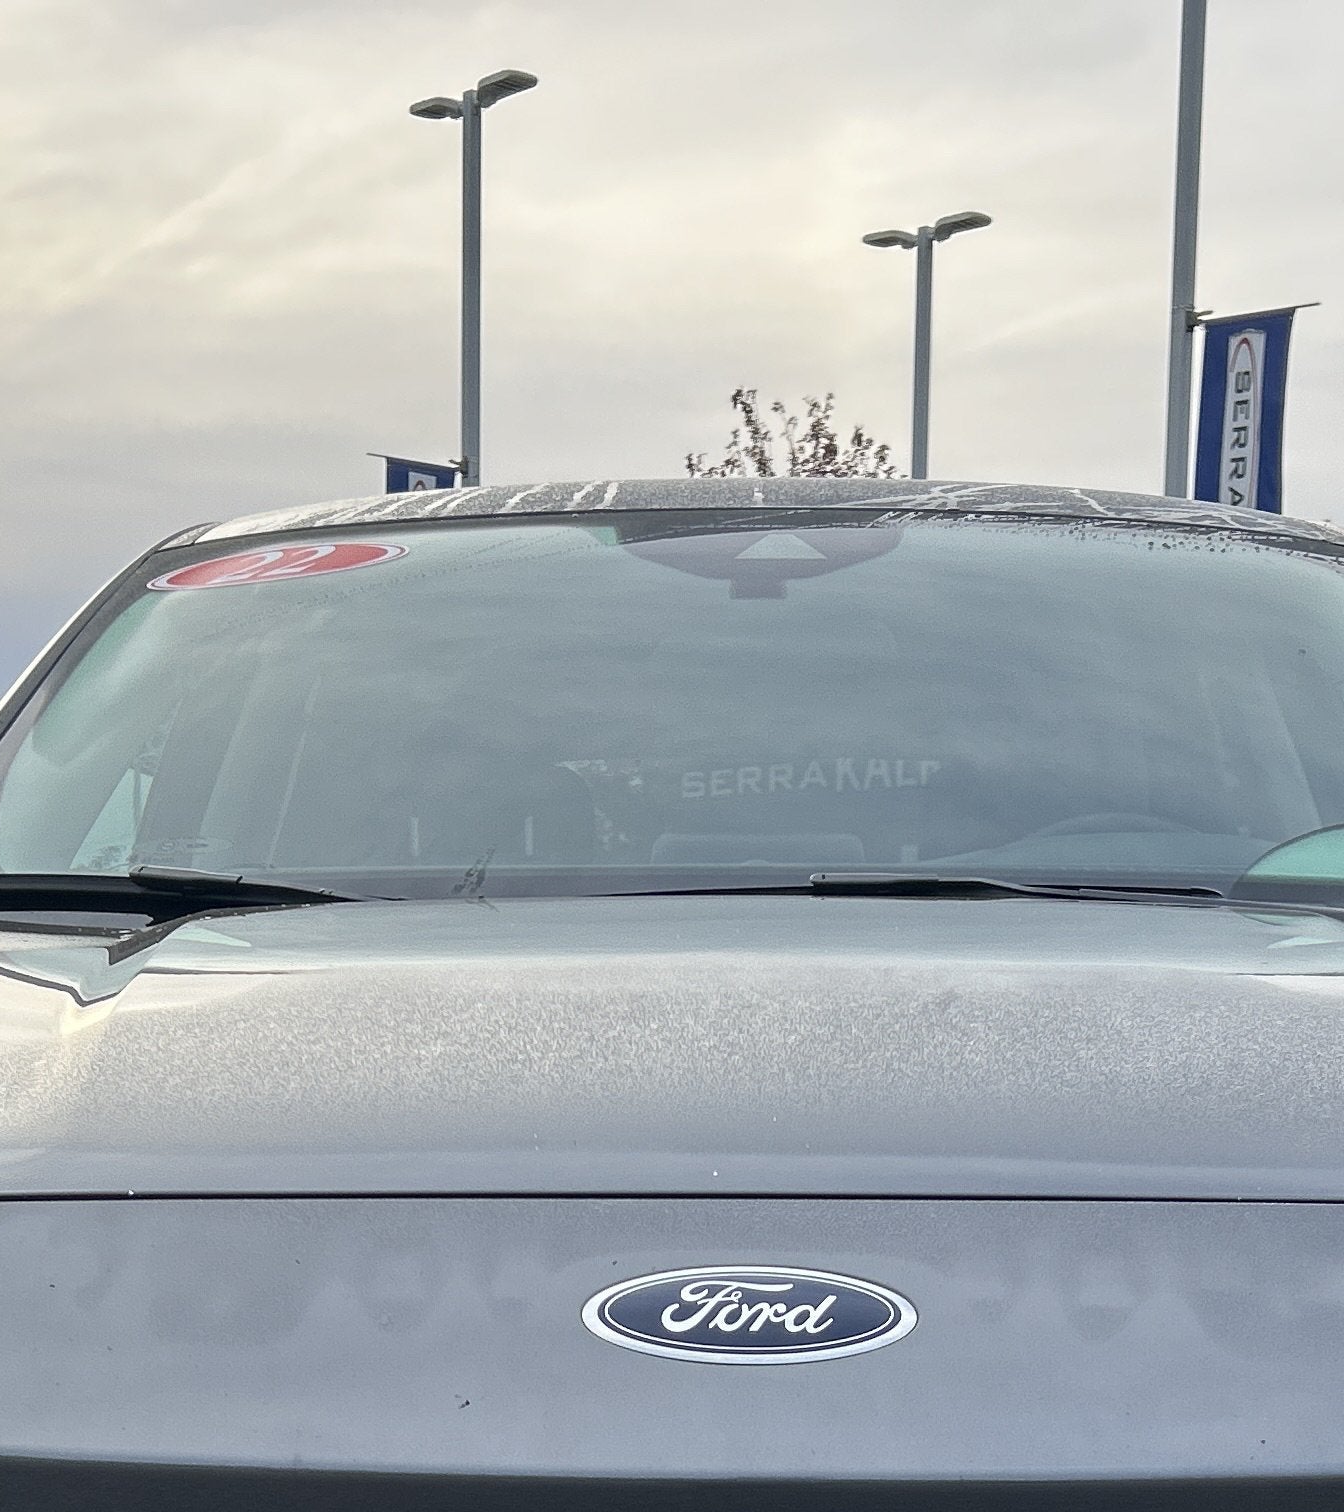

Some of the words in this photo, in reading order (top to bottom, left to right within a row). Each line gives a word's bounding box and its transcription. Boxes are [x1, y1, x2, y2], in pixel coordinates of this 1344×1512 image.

[1227, 370, 1252, 507] SERRA
[205, 543, 337, 585] 22
[660, 1279, 835, 1335] Ford
